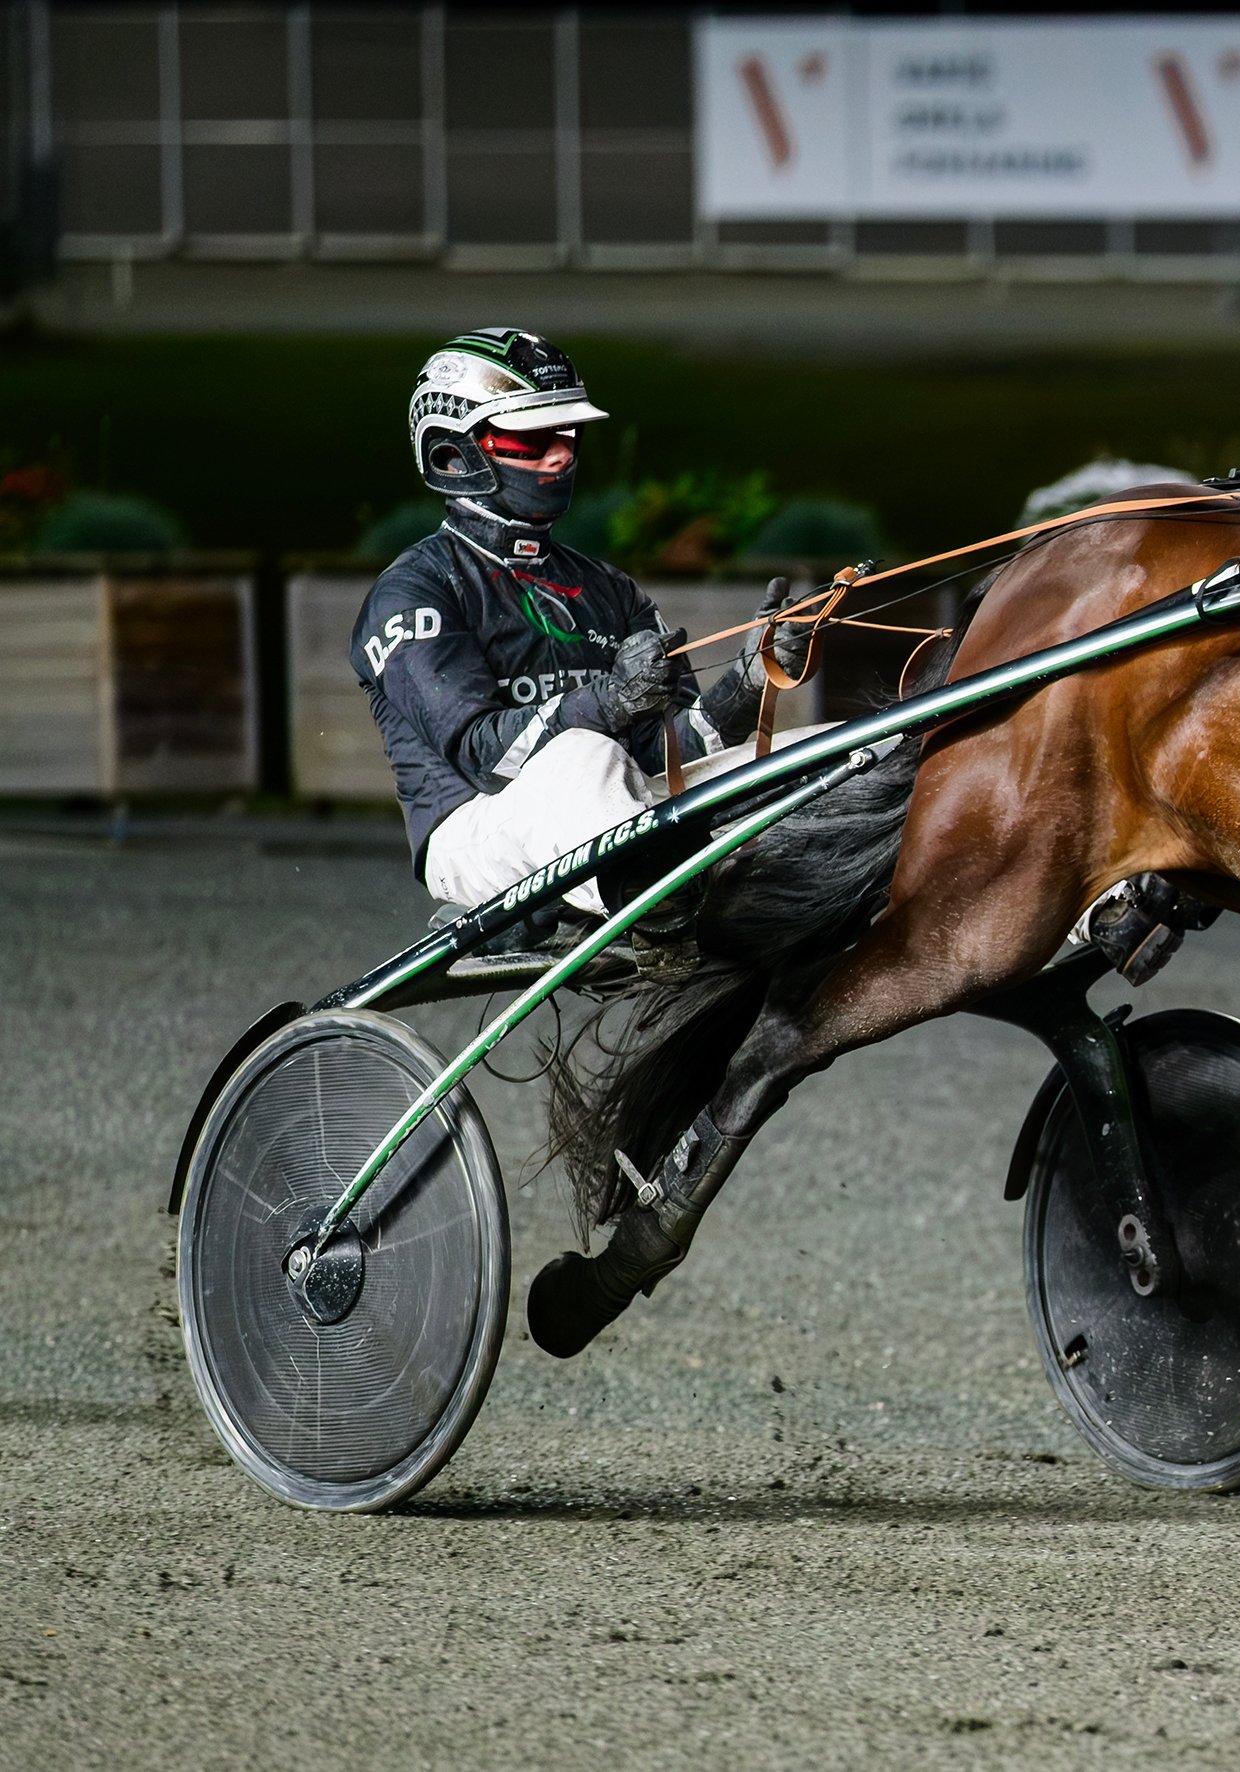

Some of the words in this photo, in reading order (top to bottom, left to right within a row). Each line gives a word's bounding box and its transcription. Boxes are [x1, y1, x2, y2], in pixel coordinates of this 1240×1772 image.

[364, 607, 442, 677] D.S.D
[503, 841, 594, 911] CUSTOM
[598, 809, 659, 856] F.C.S.
